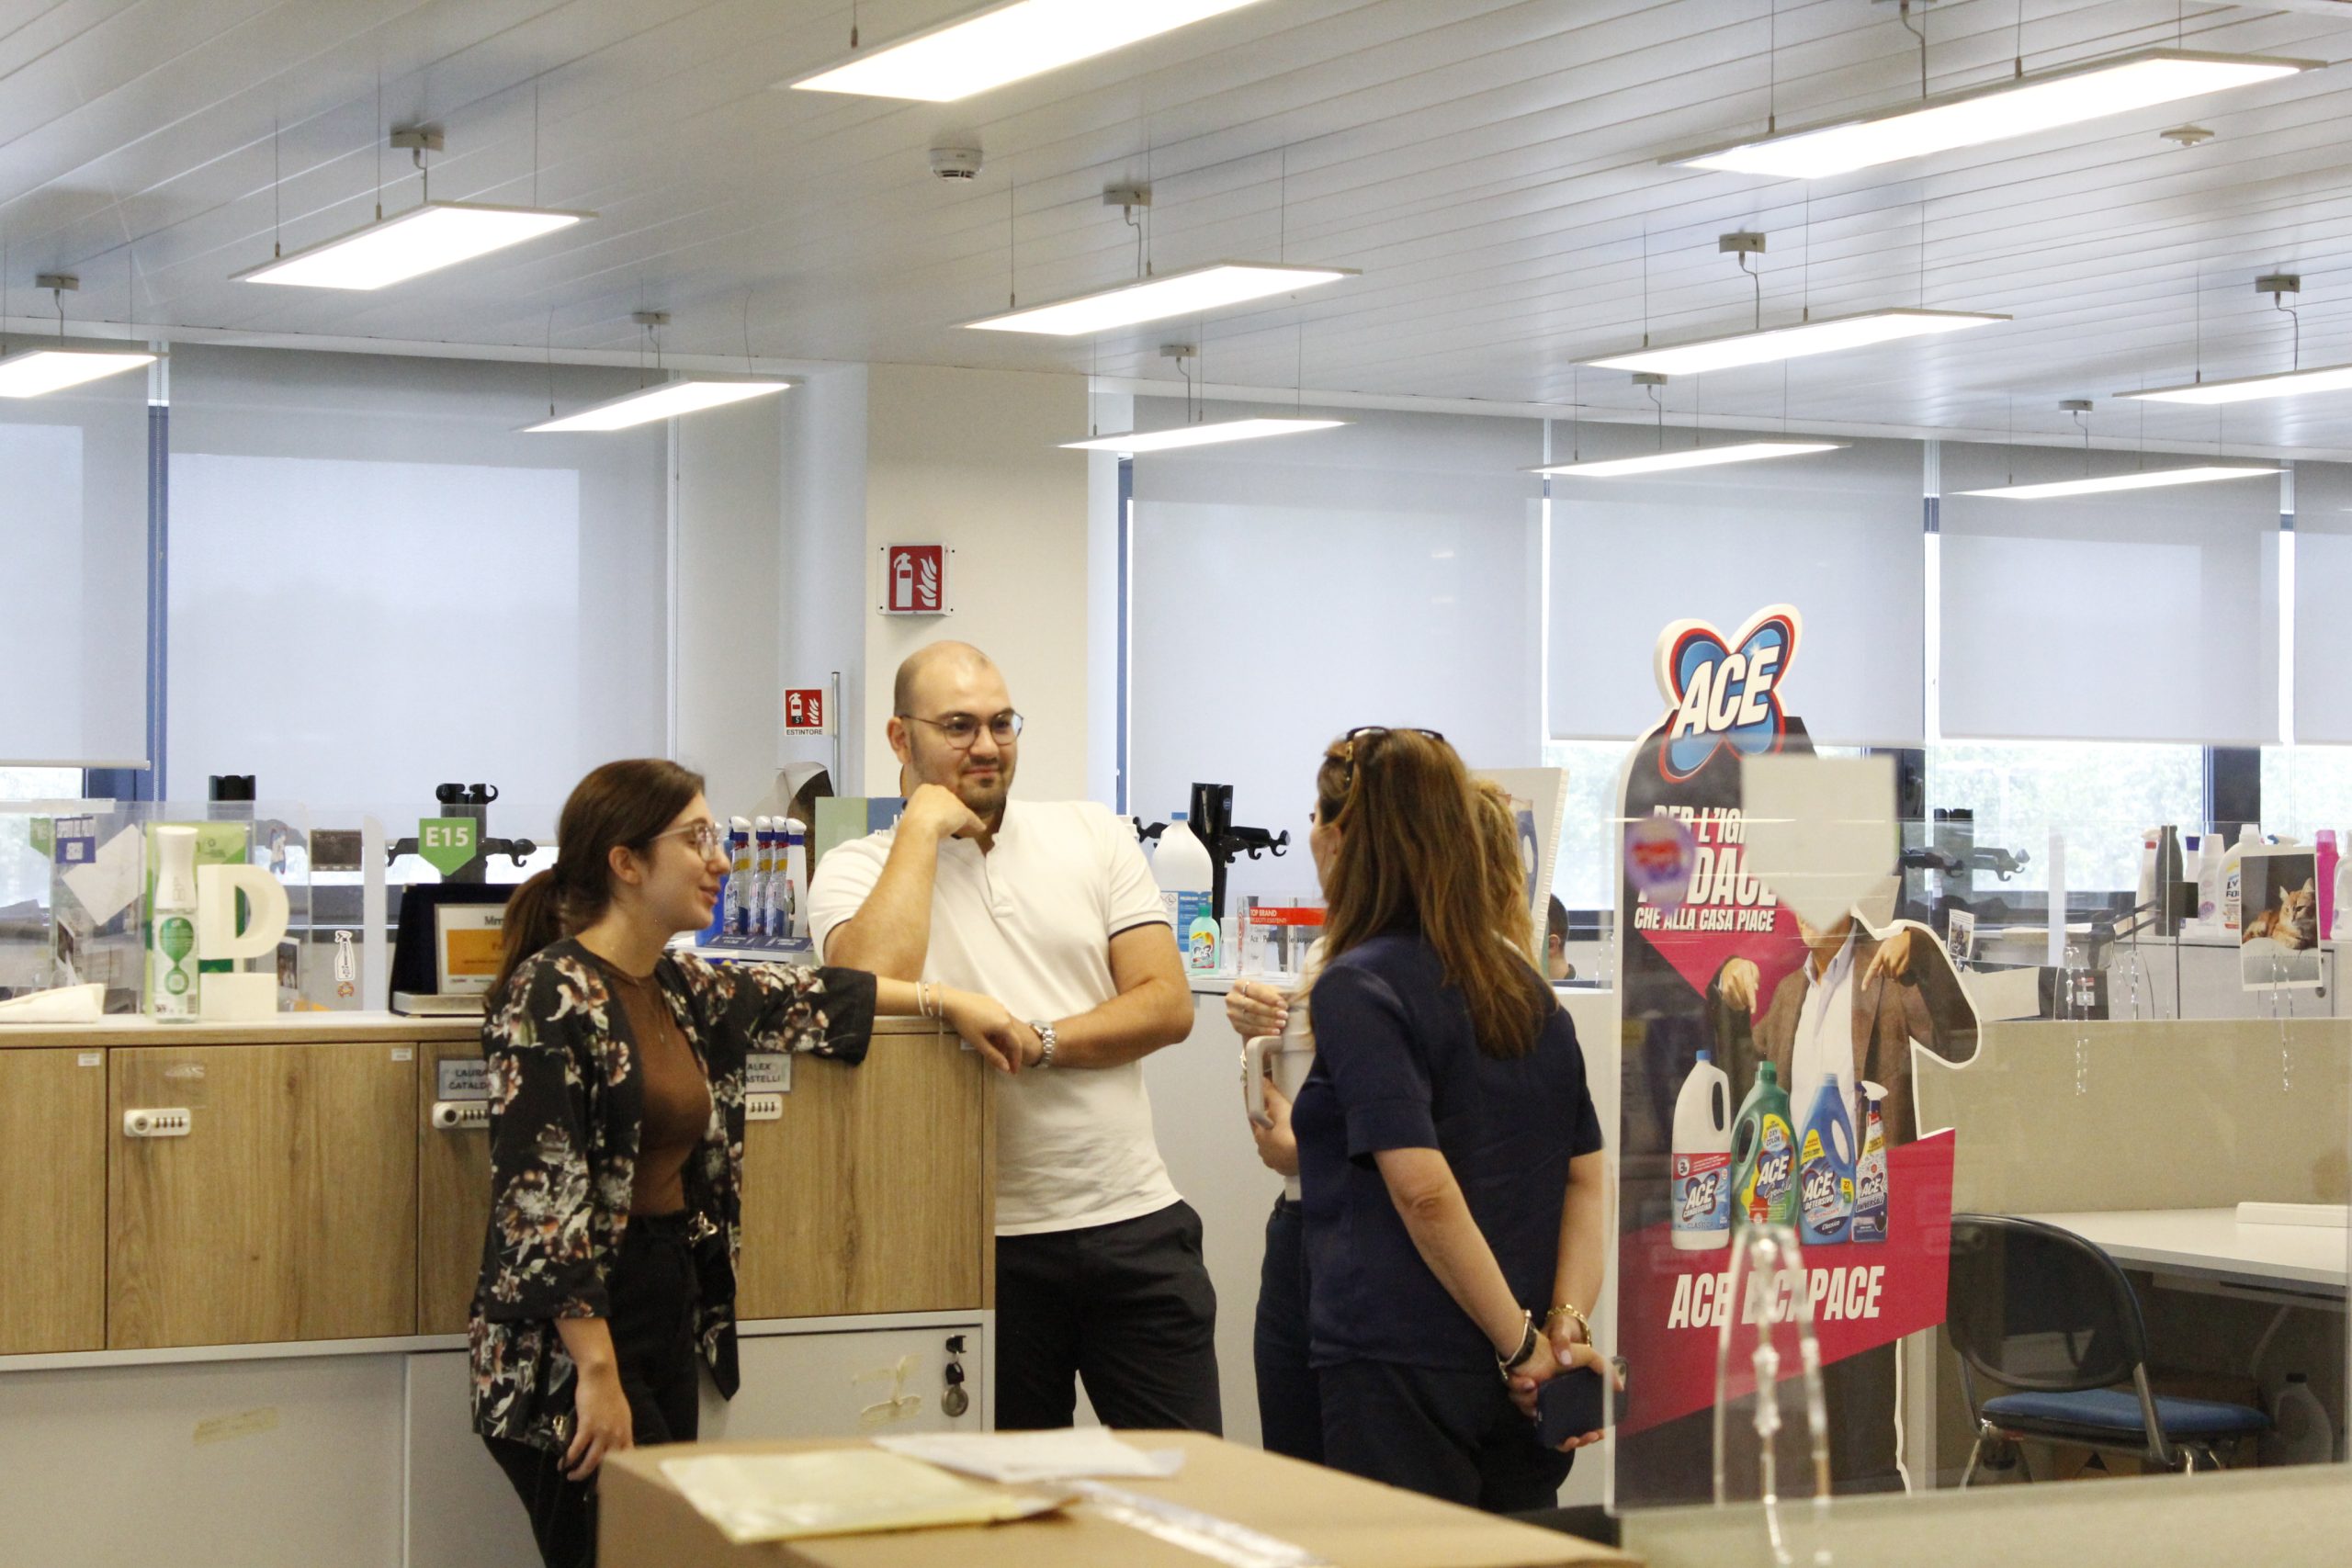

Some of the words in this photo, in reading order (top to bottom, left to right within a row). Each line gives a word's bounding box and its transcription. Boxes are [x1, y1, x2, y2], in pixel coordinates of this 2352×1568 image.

[1669, 644, 1781, 740] ACE
[425, 826, 469, 848] E15
[1634, 907, 1661, 931] CHE
[1663, 908, 1696, 931] ALLA
[1699, 908, 1735, 931] CASA
[1736, 909, 1776, 932] PIACE
[448, 1081, 488, 1090] CATALD
[1757, 1155, 1790, 1187] ACE
[1803, 1170, 1834, 1202] ACE
[1860, 1177, 1883, 1197] ACE
[1685, 1179, 1715, 1211] ACE
[1668, 1271, 1734, 1330] ACE
